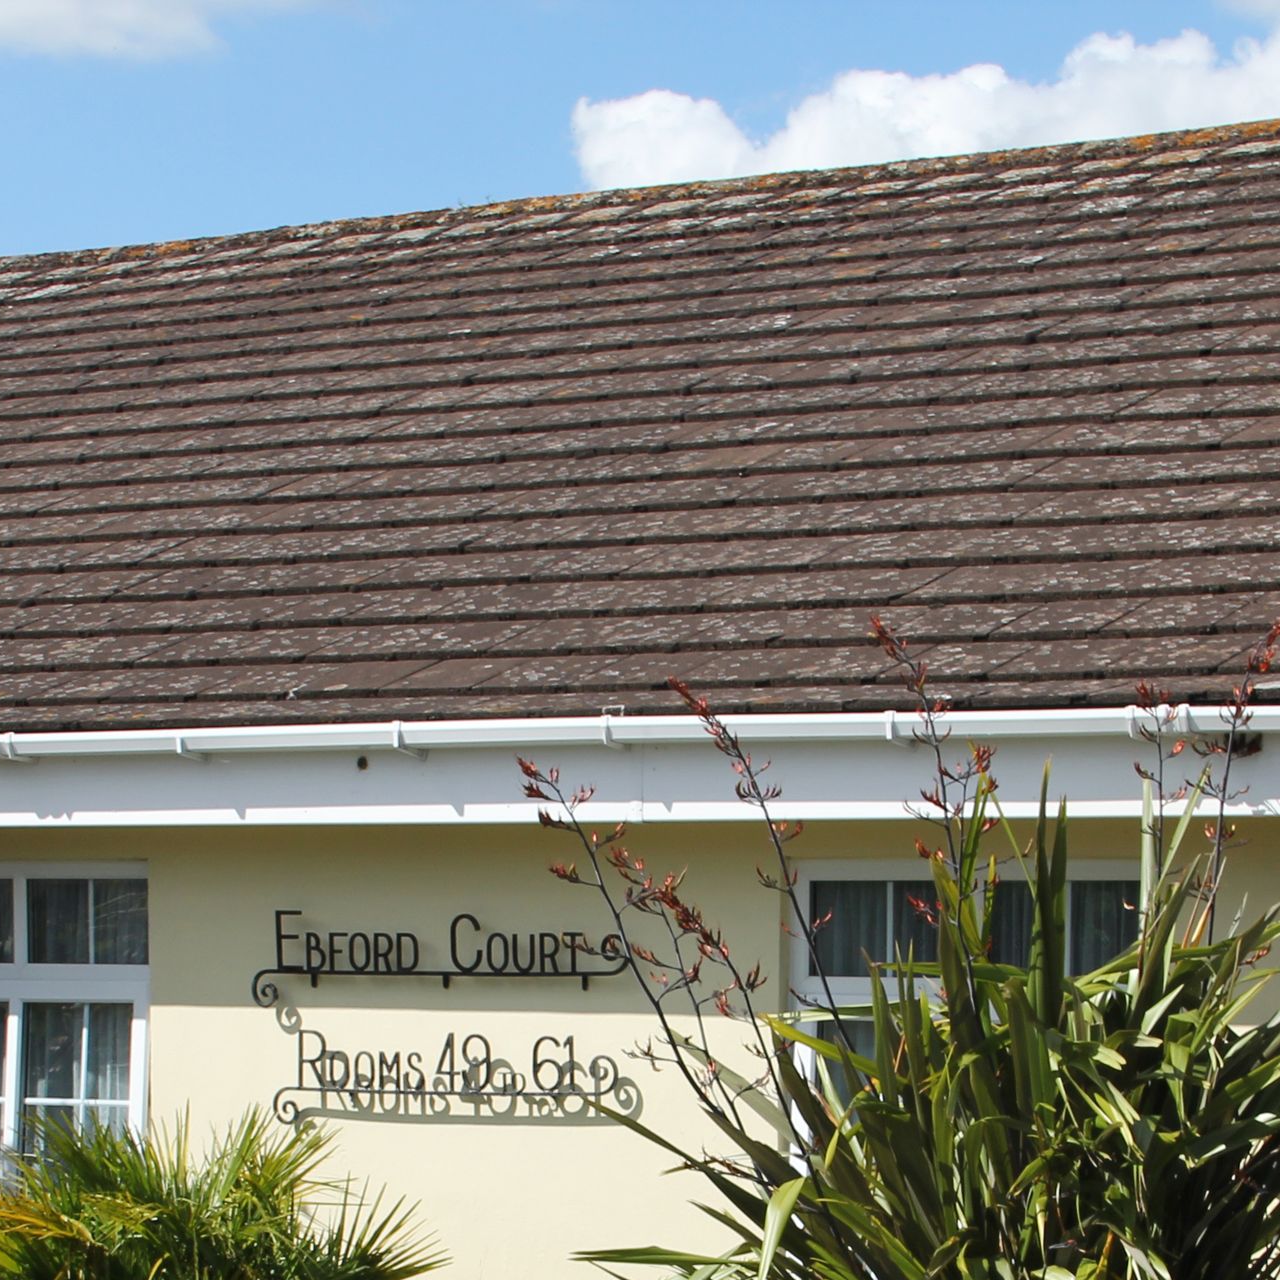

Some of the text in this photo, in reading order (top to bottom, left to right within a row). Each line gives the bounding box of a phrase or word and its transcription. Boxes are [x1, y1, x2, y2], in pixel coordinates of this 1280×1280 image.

[275, 910, 582, 974] EBFORD COURT
[298, 1030, 576, 1095] ROOMS 49 TO 61
